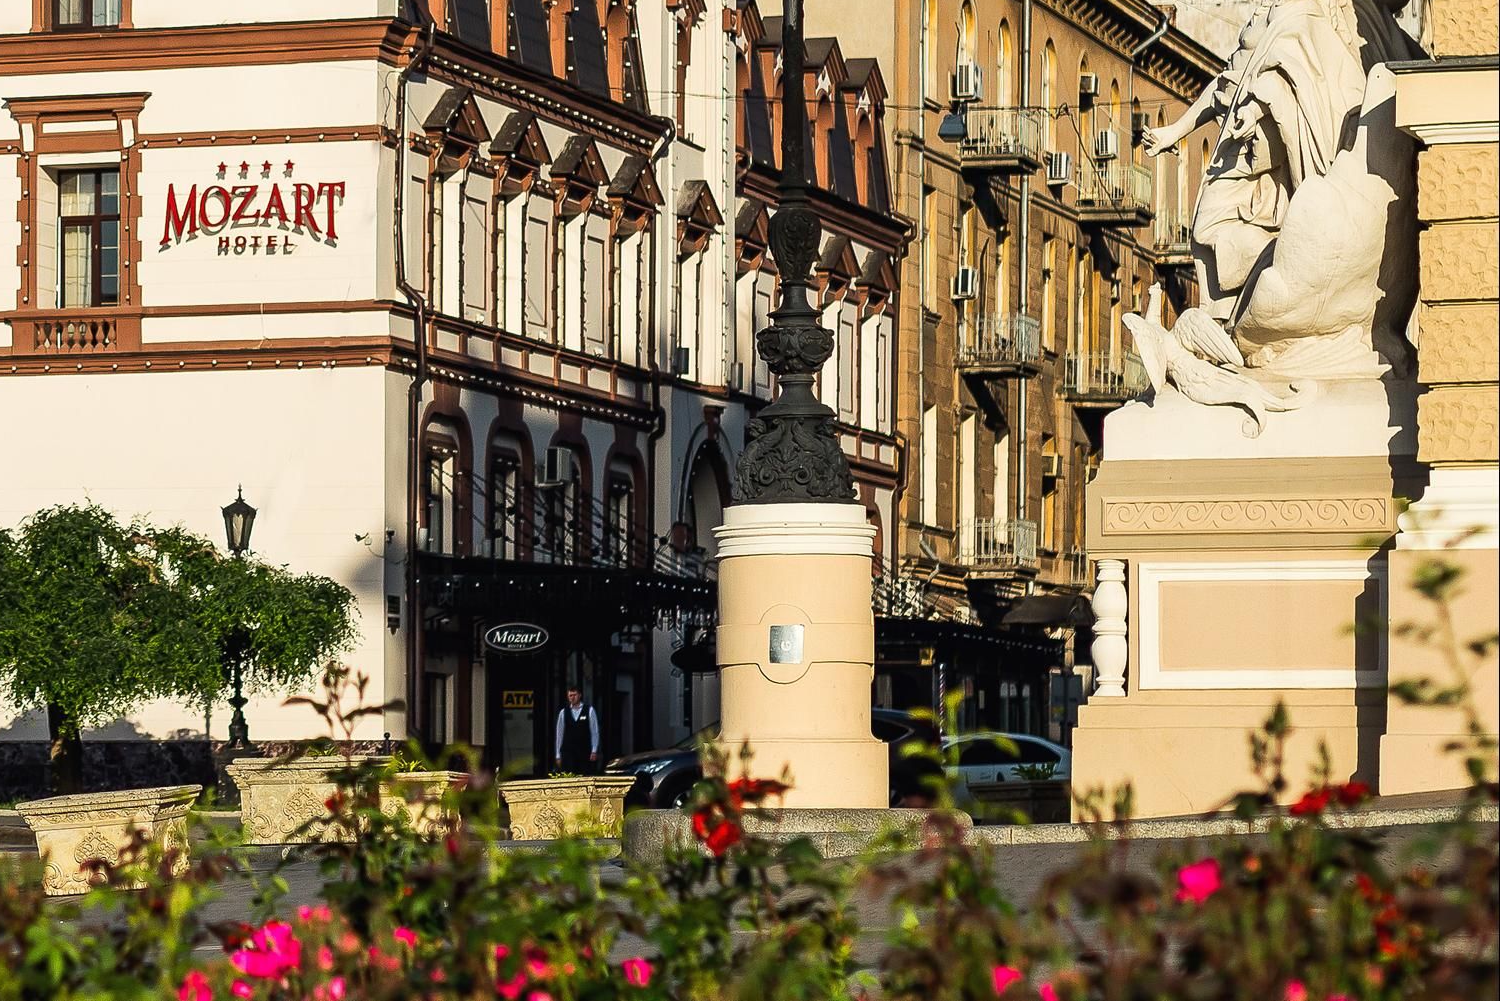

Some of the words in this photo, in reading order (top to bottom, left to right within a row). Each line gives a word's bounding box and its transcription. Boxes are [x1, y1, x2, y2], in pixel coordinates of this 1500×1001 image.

[159, 181, 346, 246] MOZART
[218, 235, 295, 248] HOTEL
[505, 692, 534, 705] ATM
